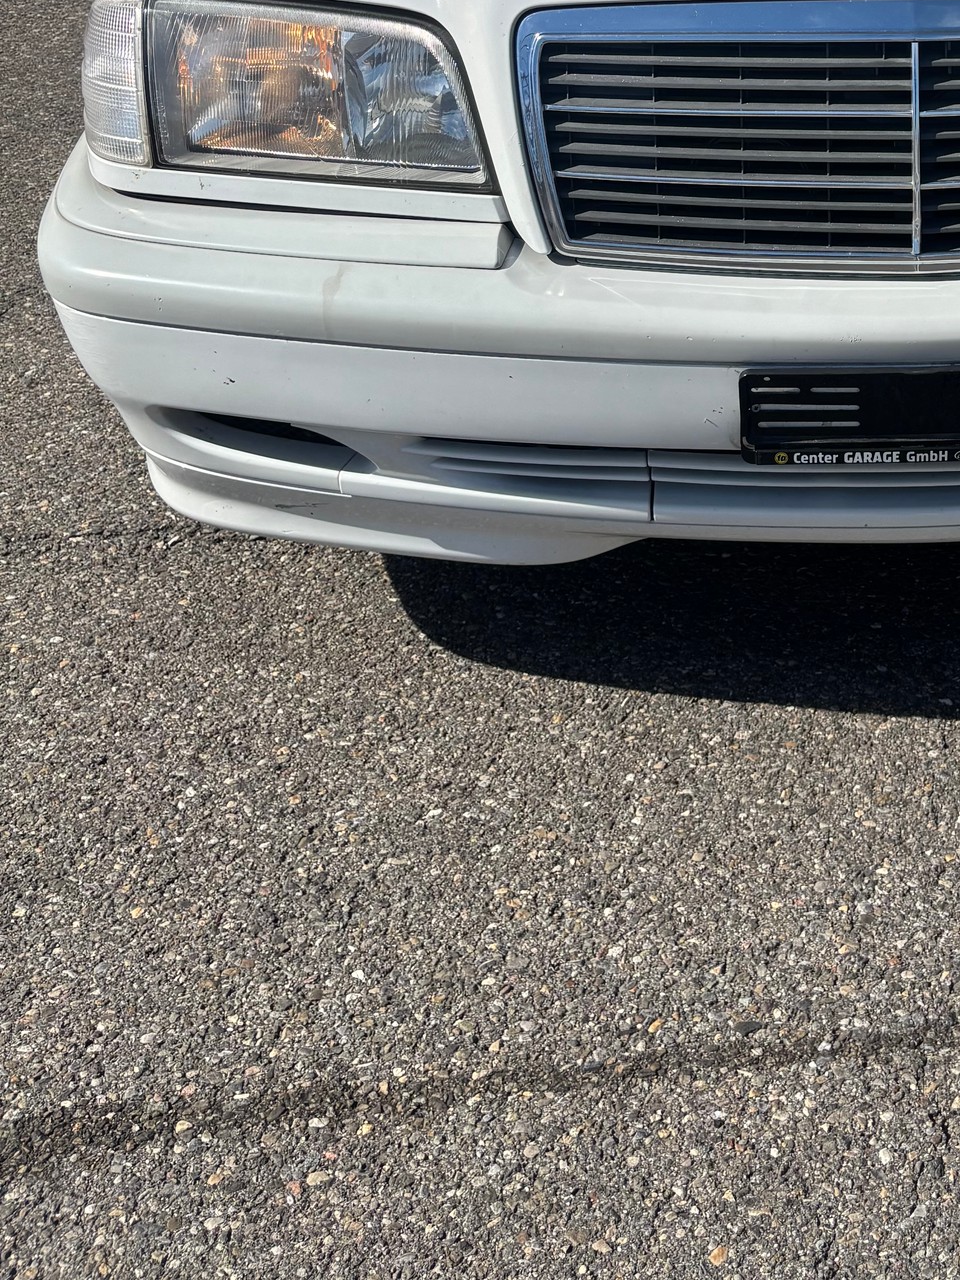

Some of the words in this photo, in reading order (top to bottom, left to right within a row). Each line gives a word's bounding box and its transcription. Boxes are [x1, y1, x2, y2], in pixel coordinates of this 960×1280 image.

[793, 452, 838, 464] Center
[843, 451, 900, 464] GARAGE
[906, 450, 949, 462] GmbH
